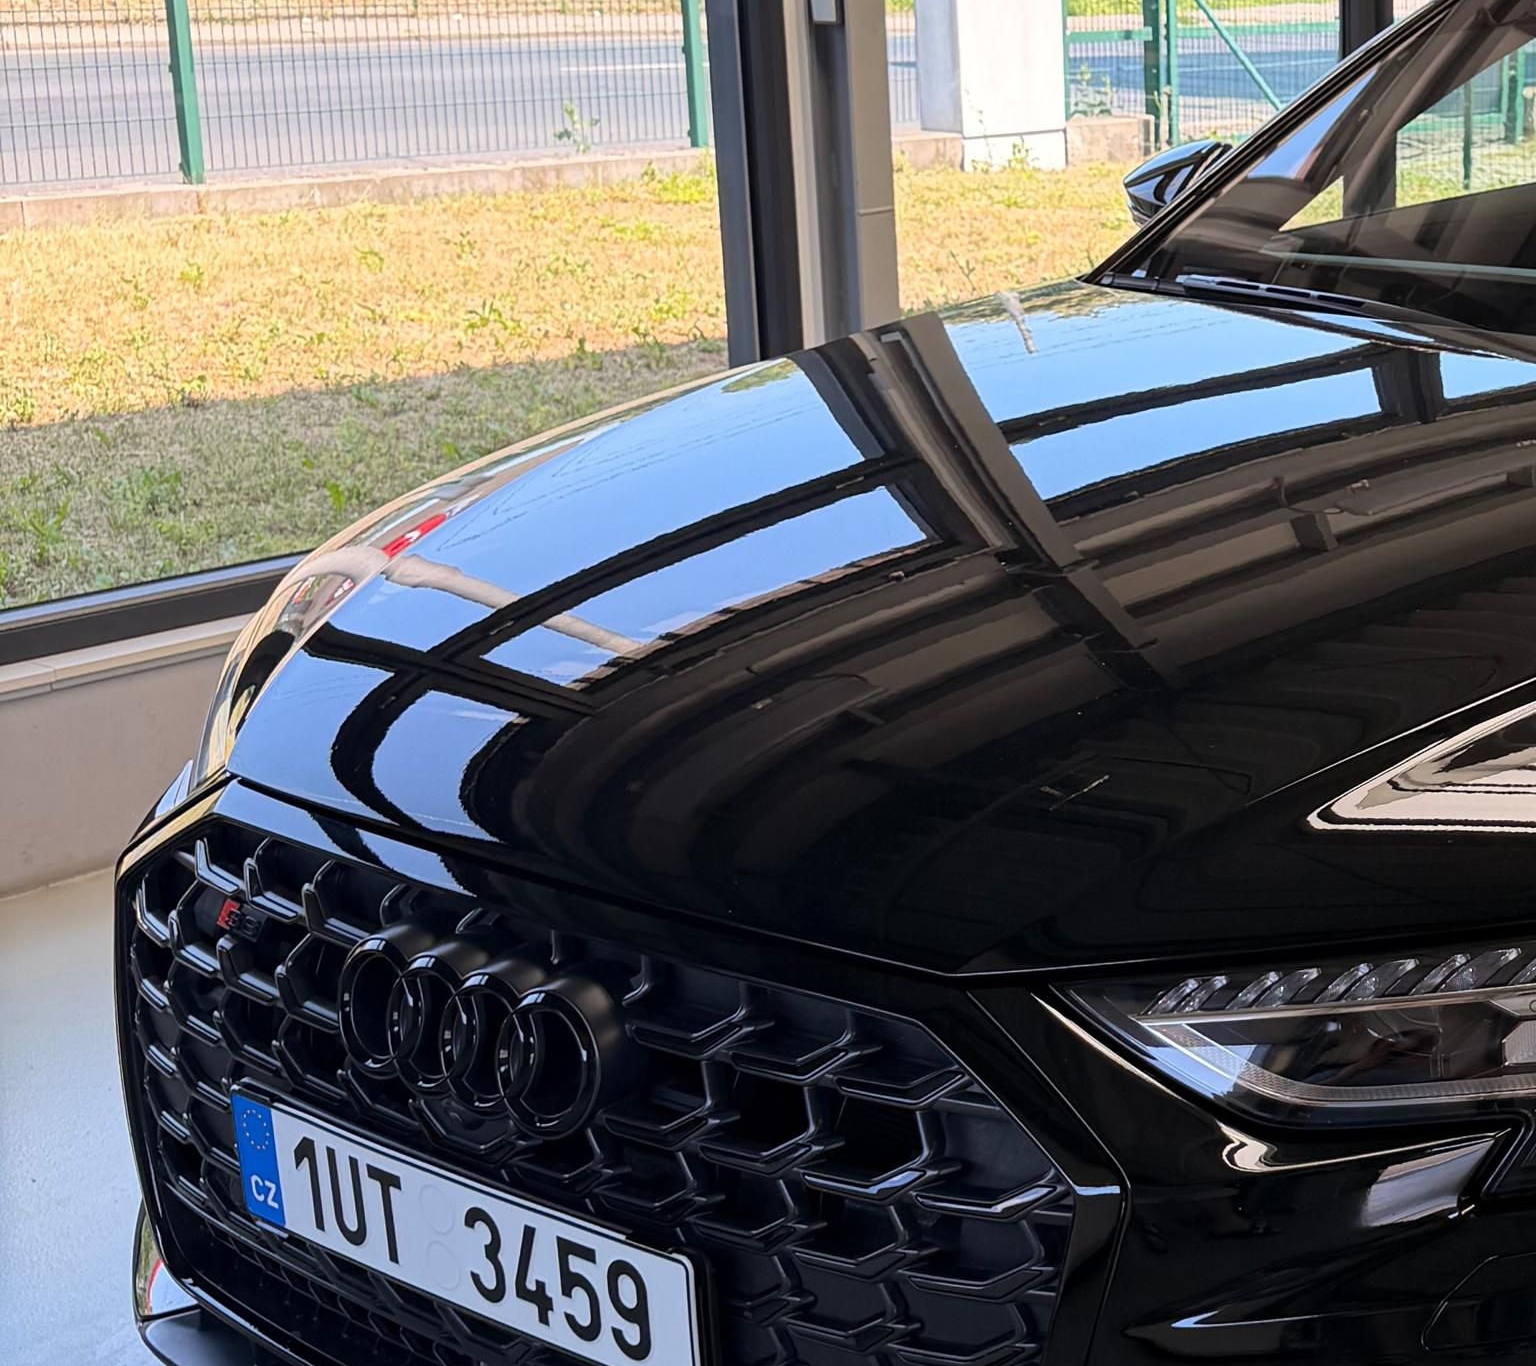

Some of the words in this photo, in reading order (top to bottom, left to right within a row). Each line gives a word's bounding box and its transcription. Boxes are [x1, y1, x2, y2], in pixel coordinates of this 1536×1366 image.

[249, 1173, 280, 1210] CZ
[294, 1136, 402, 1266] 1UT
[464, 1206, 652, 1362] 3459
